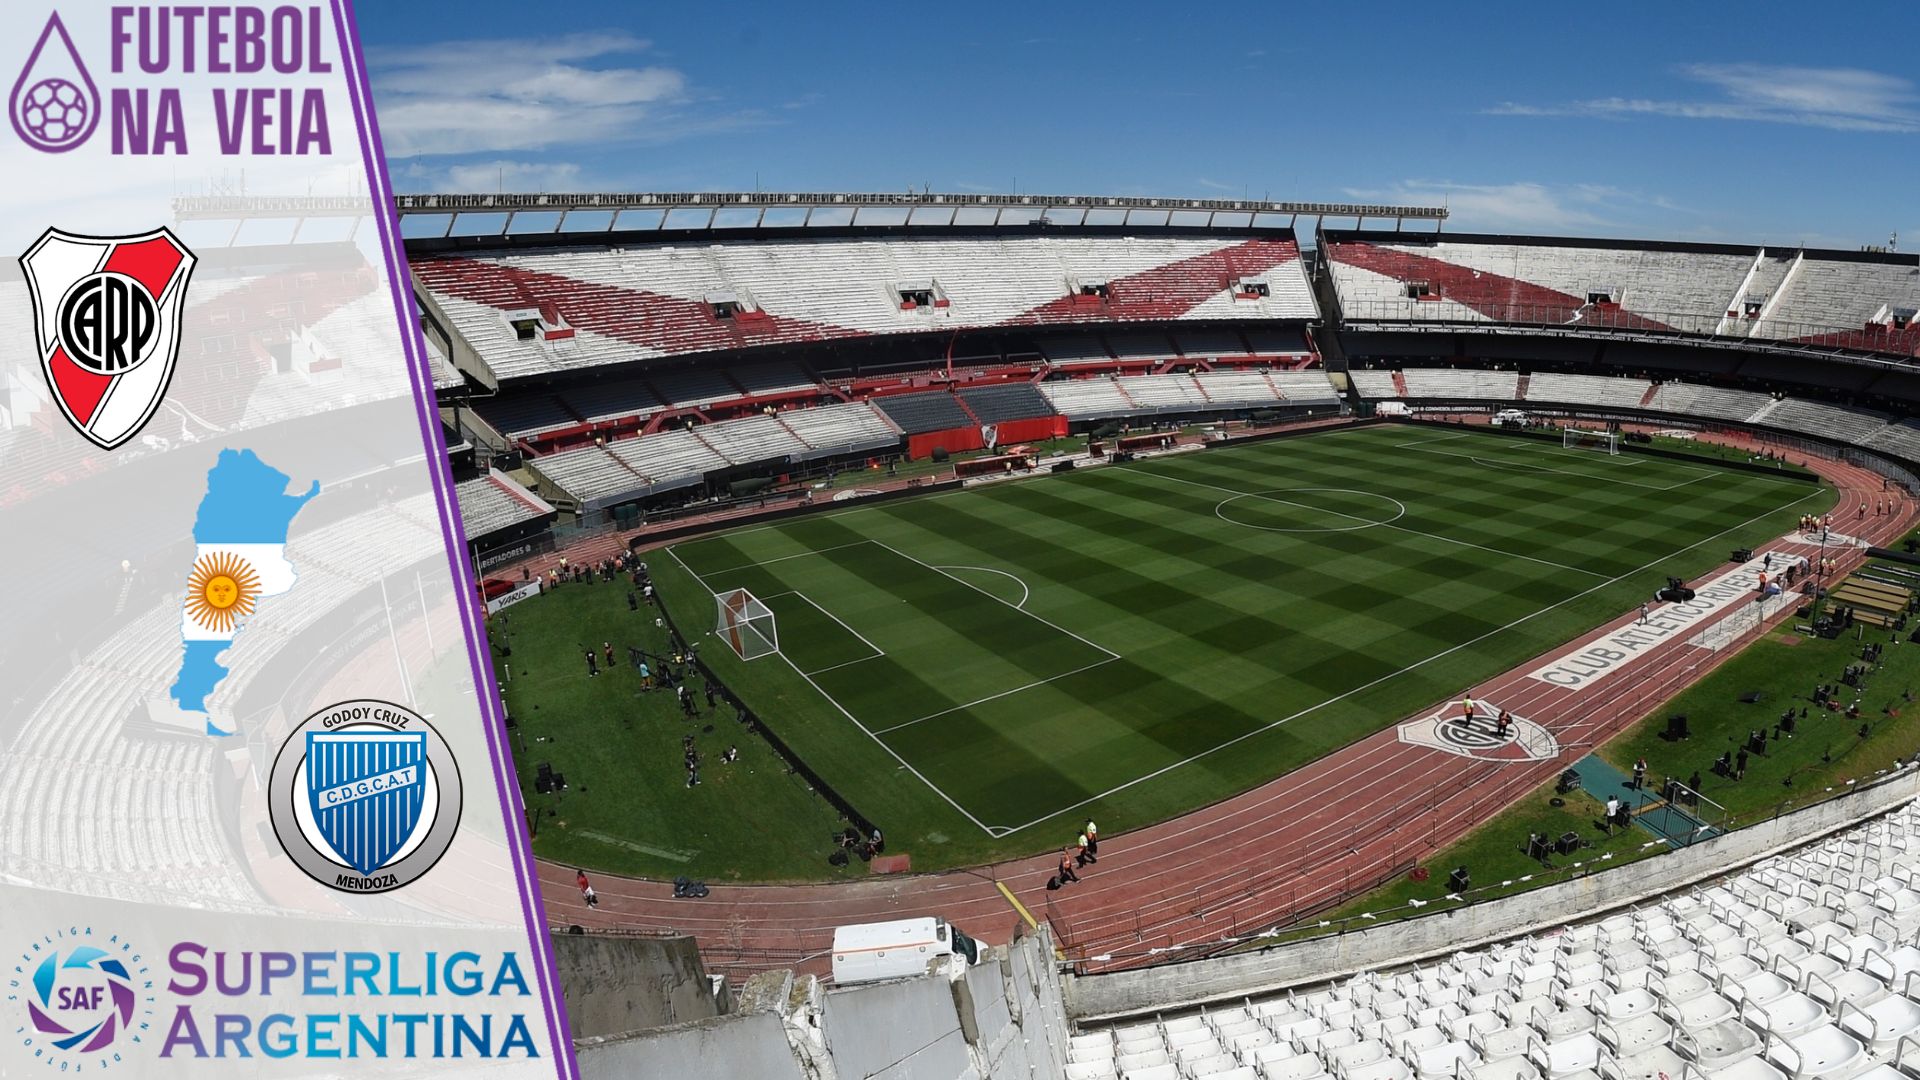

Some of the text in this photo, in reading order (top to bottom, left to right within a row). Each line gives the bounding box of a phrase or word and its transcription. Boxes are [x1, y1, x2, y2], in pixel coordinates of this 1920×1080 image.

[480, 546, 525, 569] IBERTADORES
[498, 588, 528, 607] YARIS
[1542, 647, 1627, 686] CLUB
[1698, 574, 1756, 601] RIVER
